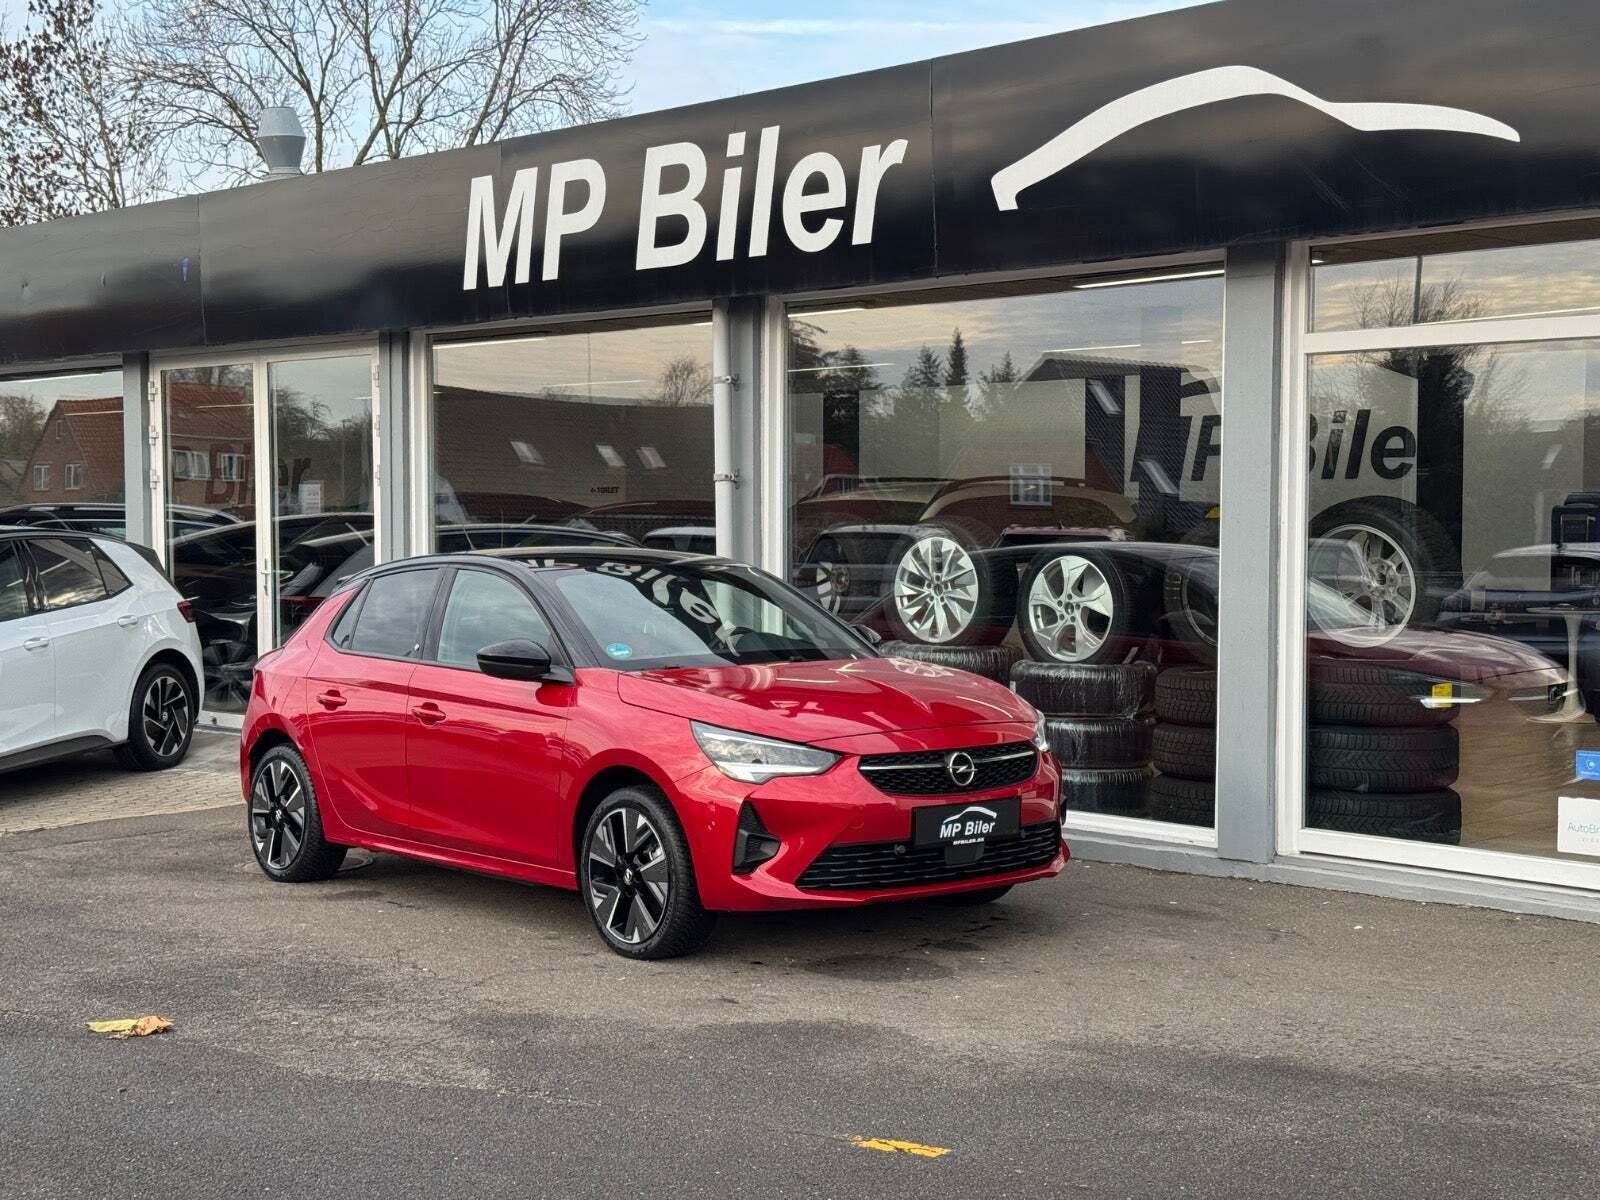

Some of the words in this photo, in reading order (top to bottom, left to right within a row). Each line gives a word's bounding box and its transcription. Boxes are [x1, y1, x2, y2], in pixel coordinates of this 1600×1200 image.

[463, 158, 607, 291] MP
[635, 125, 908, 271] Biler
[1310, 409, 1417, 481] ile
[940, 823, 961, 838] MP
[964, 820, 996, 836] Biler
